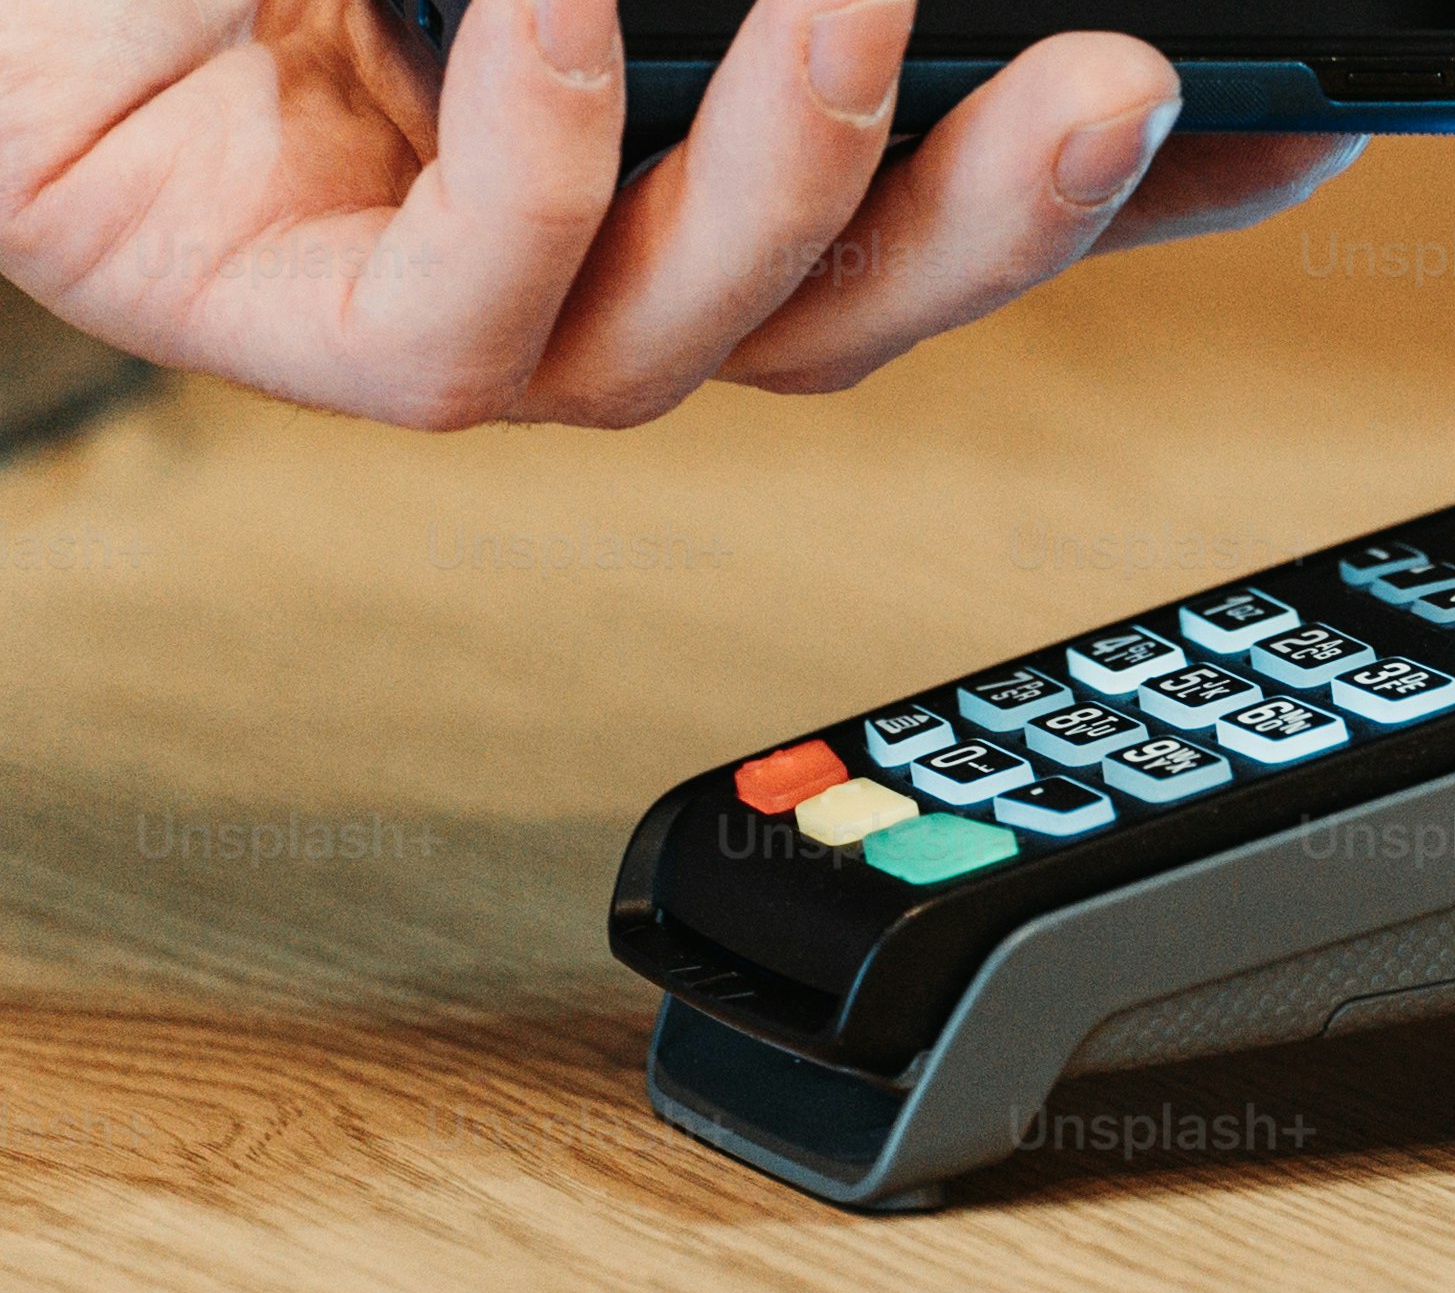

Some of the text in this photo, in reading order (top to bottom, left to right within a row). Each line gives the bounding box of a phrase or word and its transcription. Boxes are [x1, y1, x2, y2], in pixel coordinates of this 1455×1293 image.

[1204, 595, 1254, 616] 1
[1092, 635, 1143, 656] 4
[1270, 630, 1329, 654] 2
[976, 671, 1034, 691] 7
[1159, 669, 1219, 691] 5
[1354, 662, 1411, 684] 3
[1045, 708, 1104, 729] 8
[1237, 701, 1295, 724] 6
[930, 746, 987, 768] 0
[1122, 740, 1181, 762] 9
